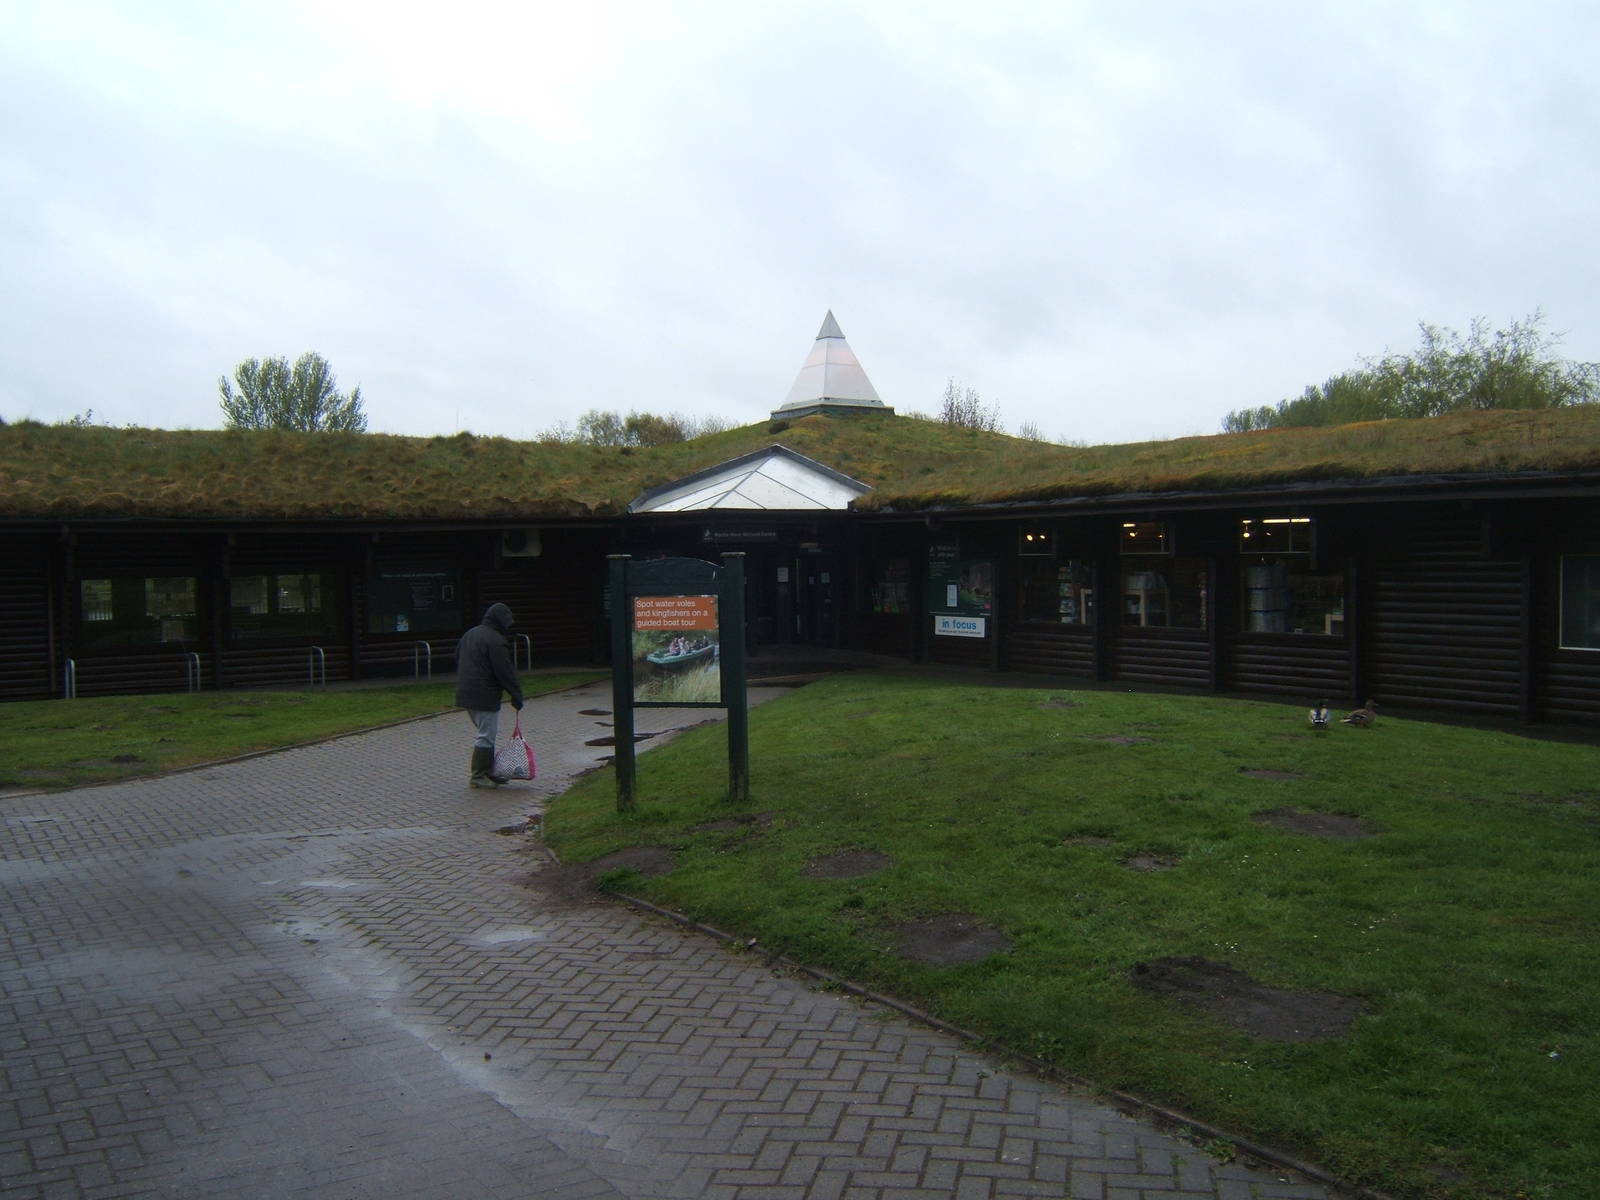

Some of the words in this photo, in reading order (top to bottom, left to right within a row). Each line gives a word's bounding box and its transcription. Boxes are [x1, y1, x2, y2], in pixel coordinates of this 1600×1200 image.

[636, 600, 653, 609] Spot
[677, 599, 696, 607] voles
[636, 609, 650, 617] and
[652, 609, 690, 618] kingfishers
[637, 619, 661, 628] guided
[942, 618, 950, 628] in
[952, 619, 977, 630] focus
